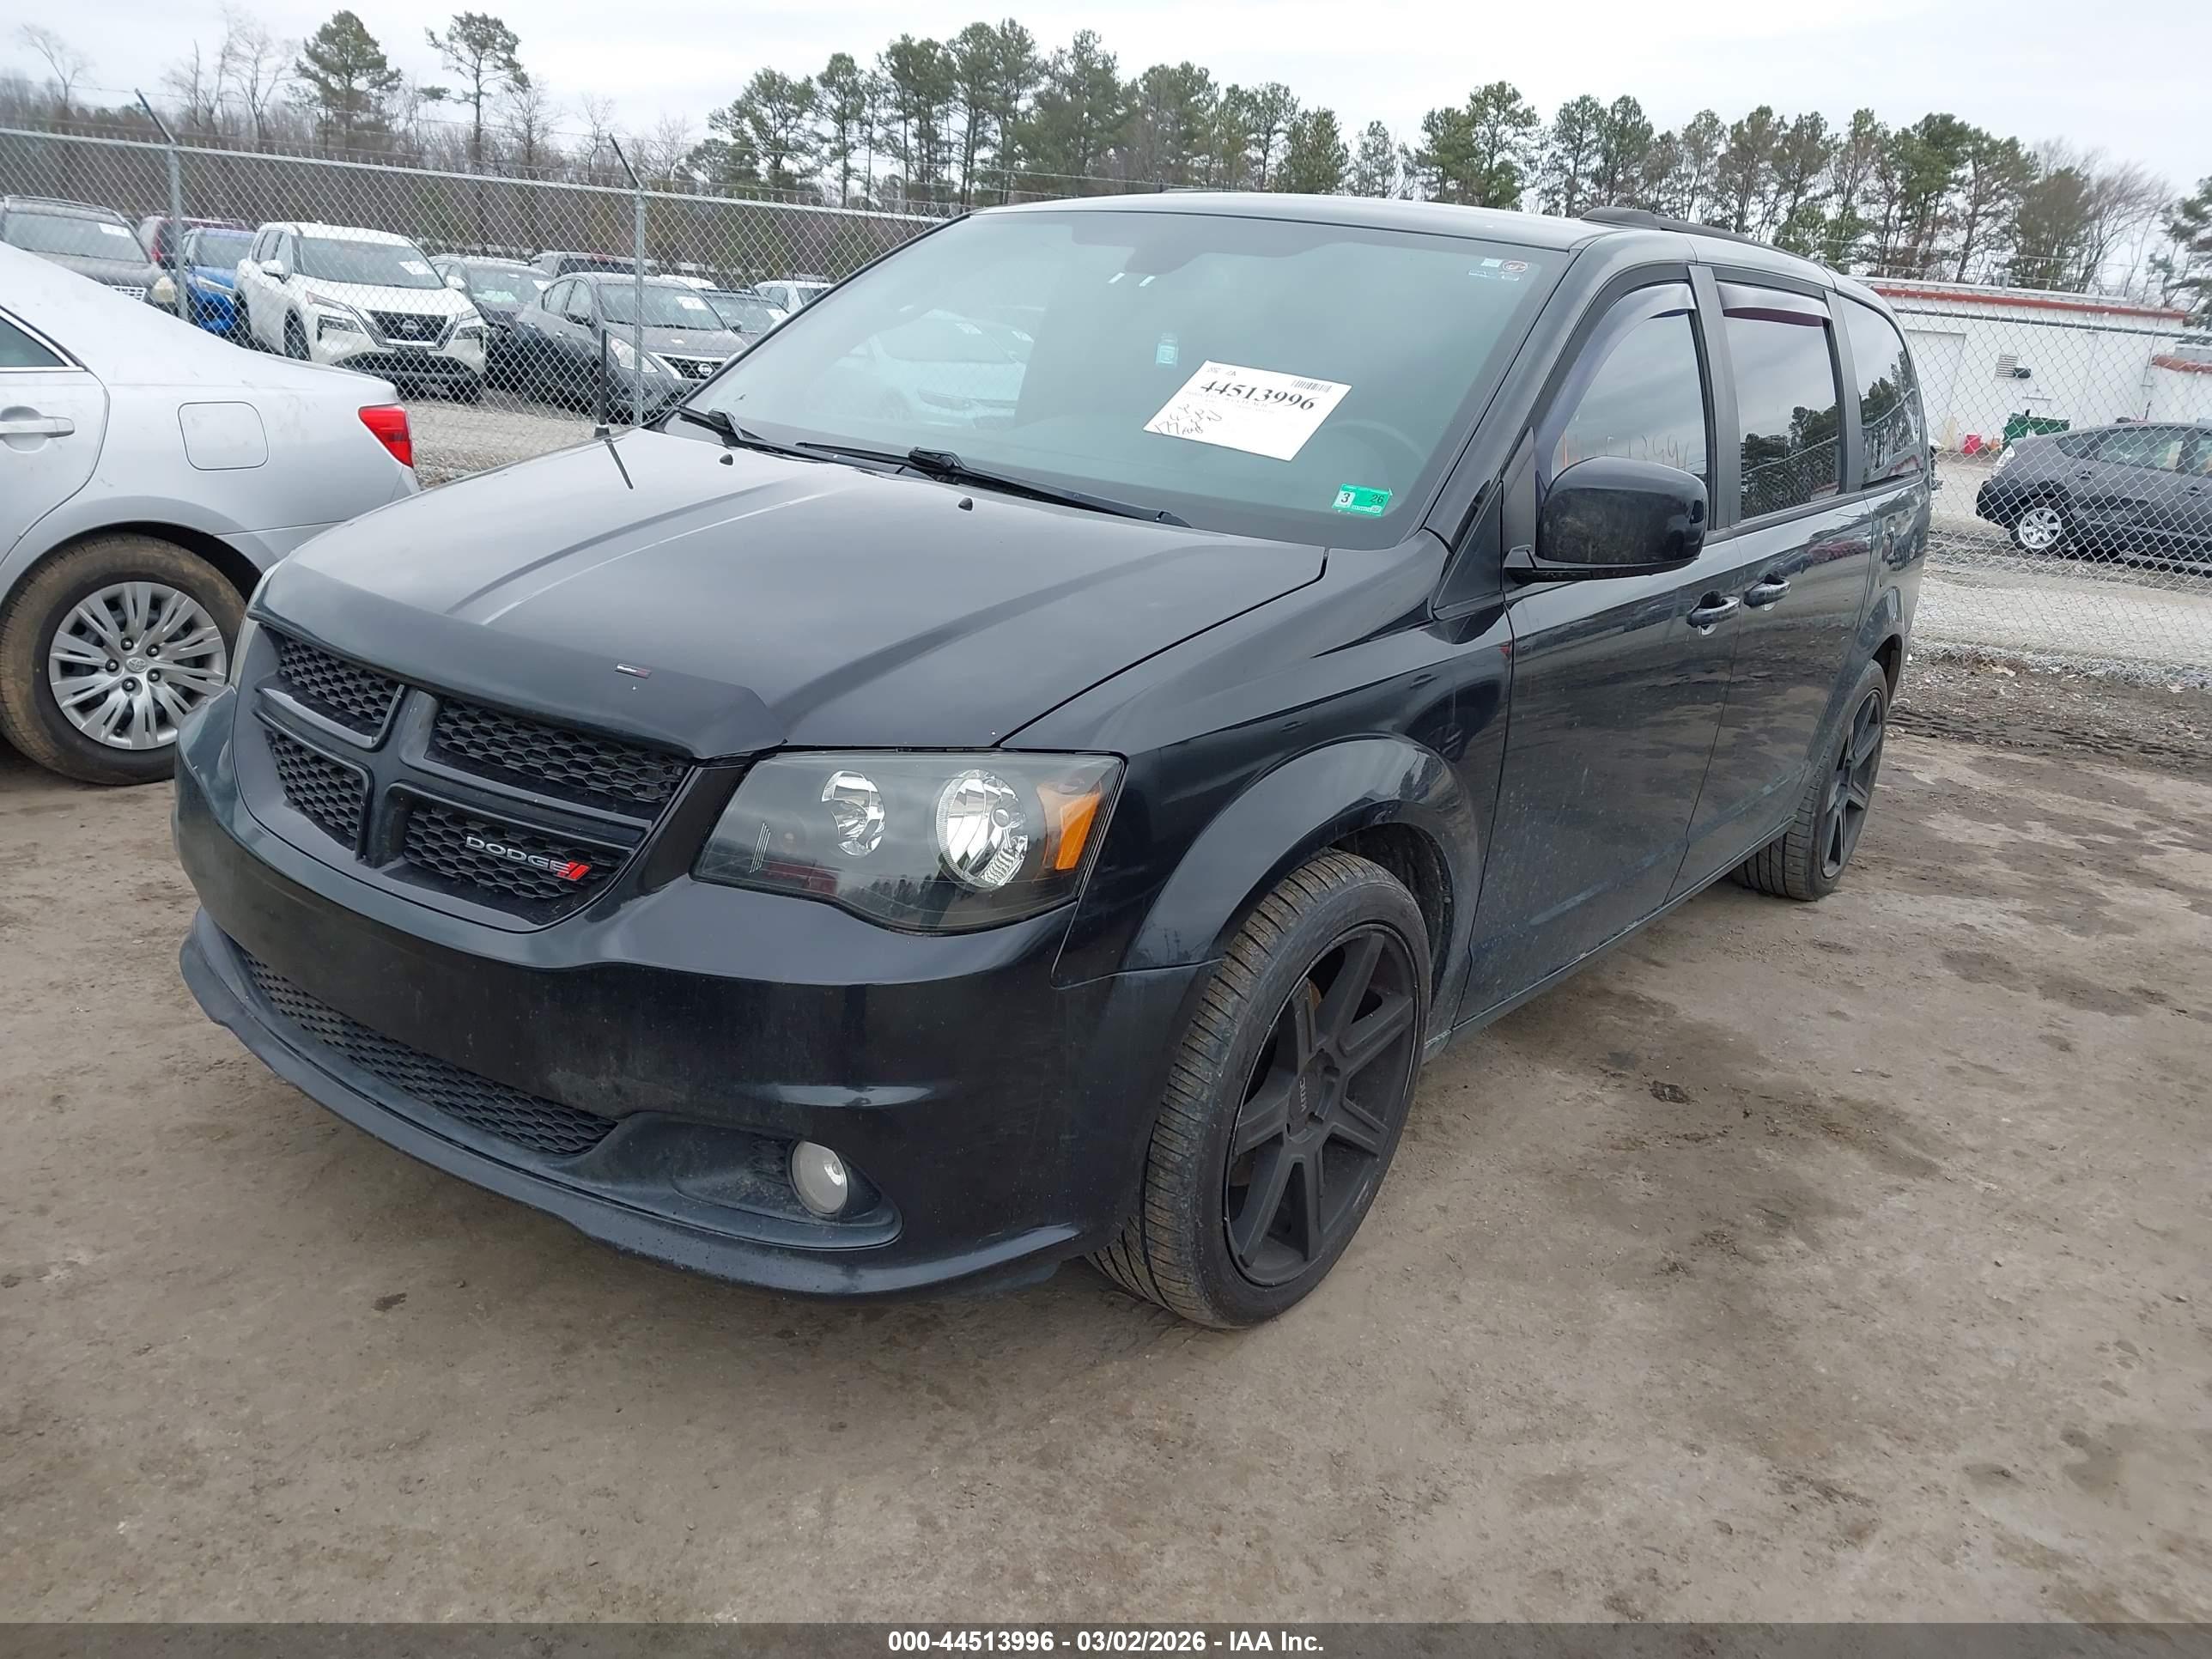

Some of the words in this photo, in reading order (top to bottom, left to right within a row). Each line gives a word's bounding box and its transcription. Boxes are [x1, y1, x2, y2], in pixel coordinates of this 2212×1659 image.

[1200, 380, 1319, 410] 44513996
[1340, 493, 1351, 503] 3
[1370, 494, 1385, 504] 26
[466, 836, 571, 874] DODGE
